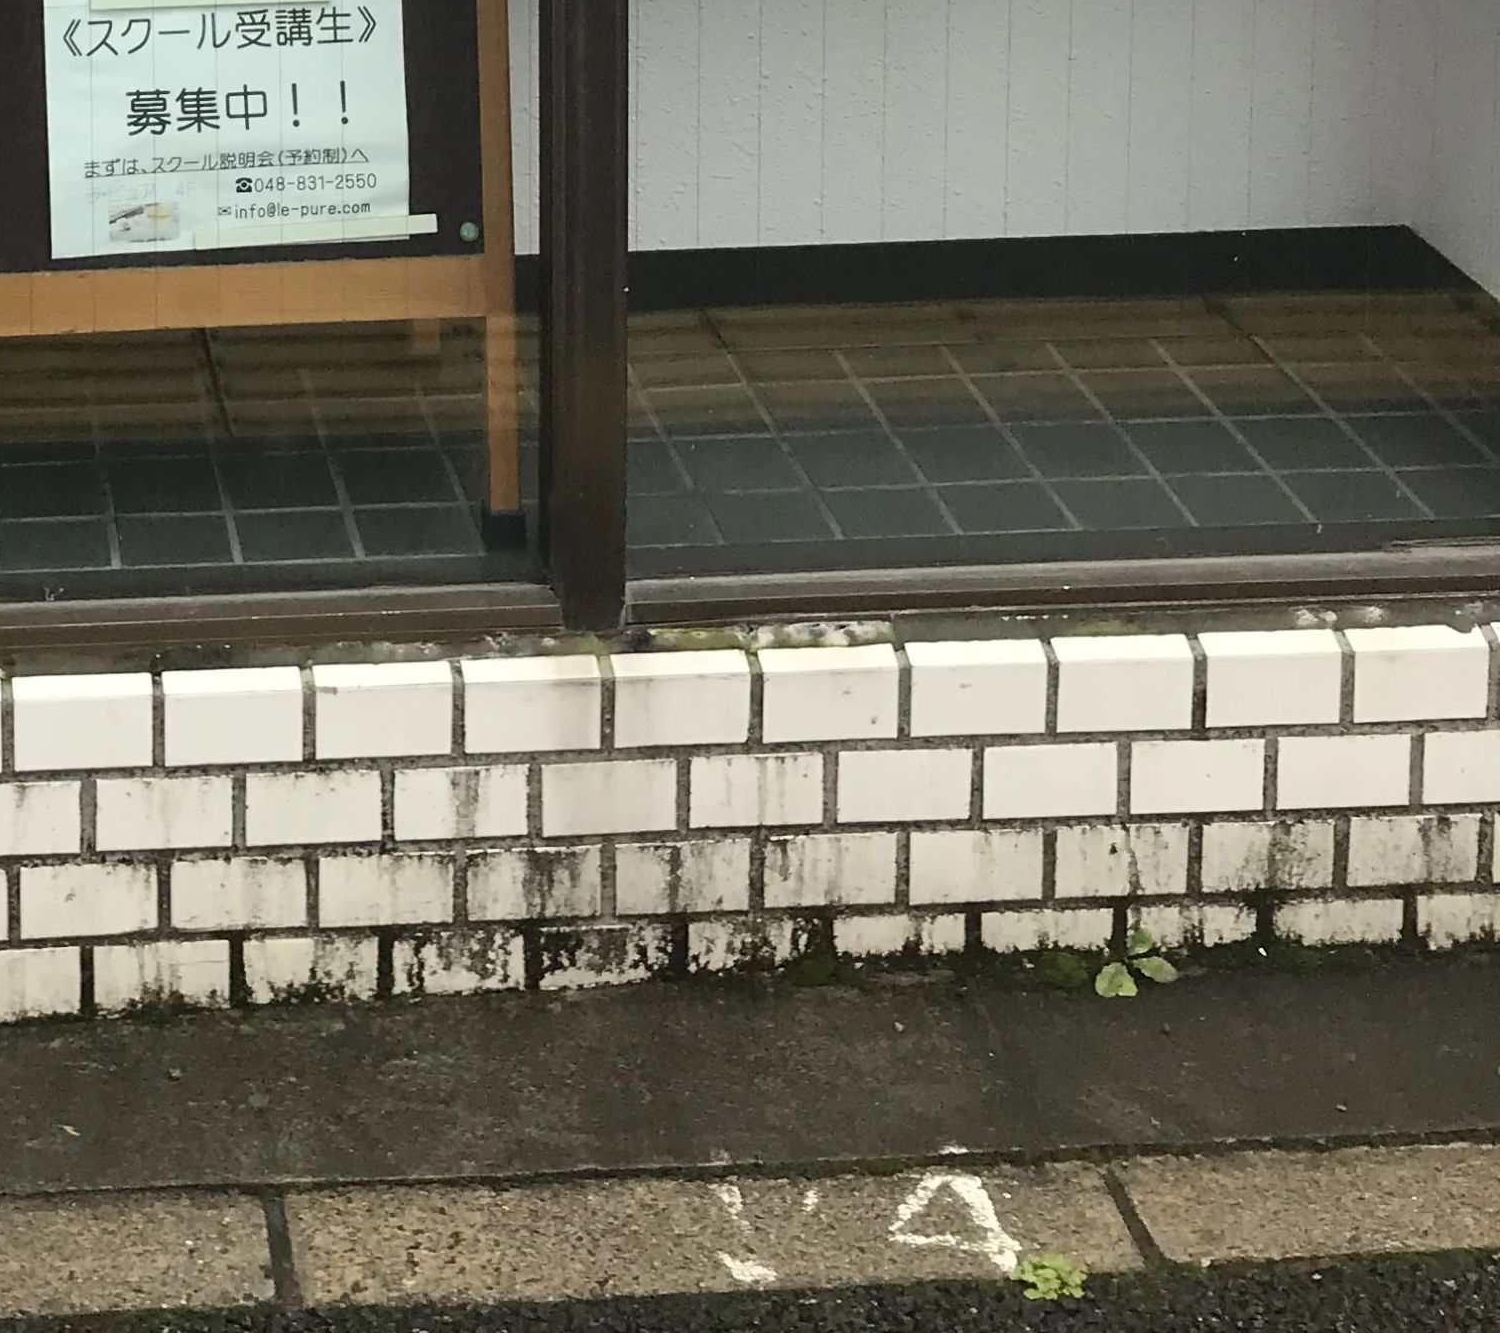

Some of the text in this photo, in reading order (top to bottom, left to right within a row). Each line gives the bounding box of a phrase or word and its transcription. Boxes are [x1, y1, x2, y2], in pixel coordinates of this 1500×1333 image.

[62, 5, 378, 58] 《スクール受講生》
[126, 79, 350, 136] 募集中！！
[254, 173, 378, 193] 048-831-2550
[233, 199, 371, 220] info@le-pure.com
